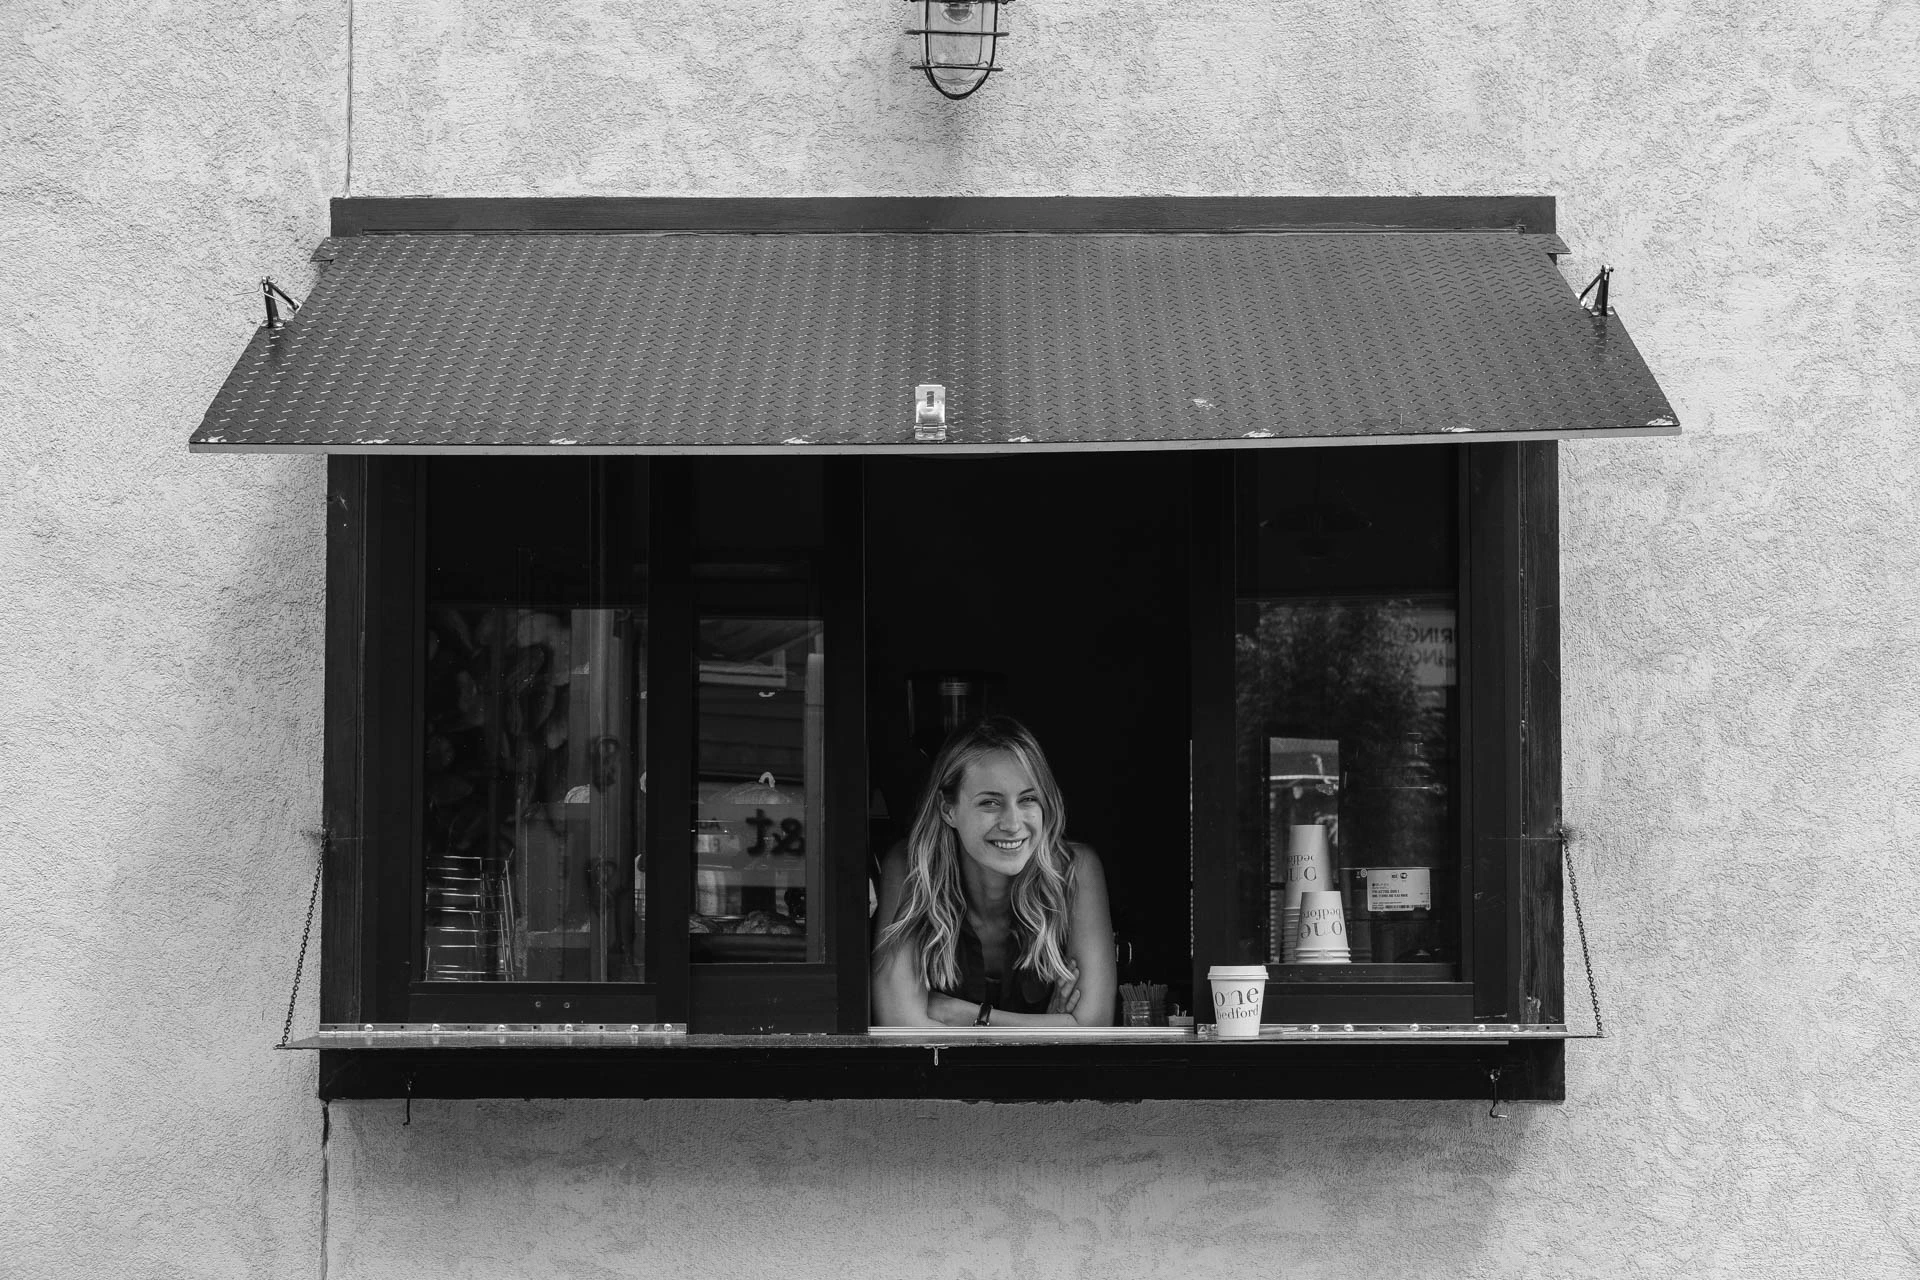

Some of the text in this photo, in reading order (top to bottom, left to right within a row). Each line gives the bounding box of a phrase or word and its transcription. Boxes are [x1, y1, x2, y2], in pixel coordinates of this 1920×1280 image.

[1300, 920, 1342, 939] one
[1214, 987, 1259, 1007] one
[1215, 1004, 1259, 1020] bedford
